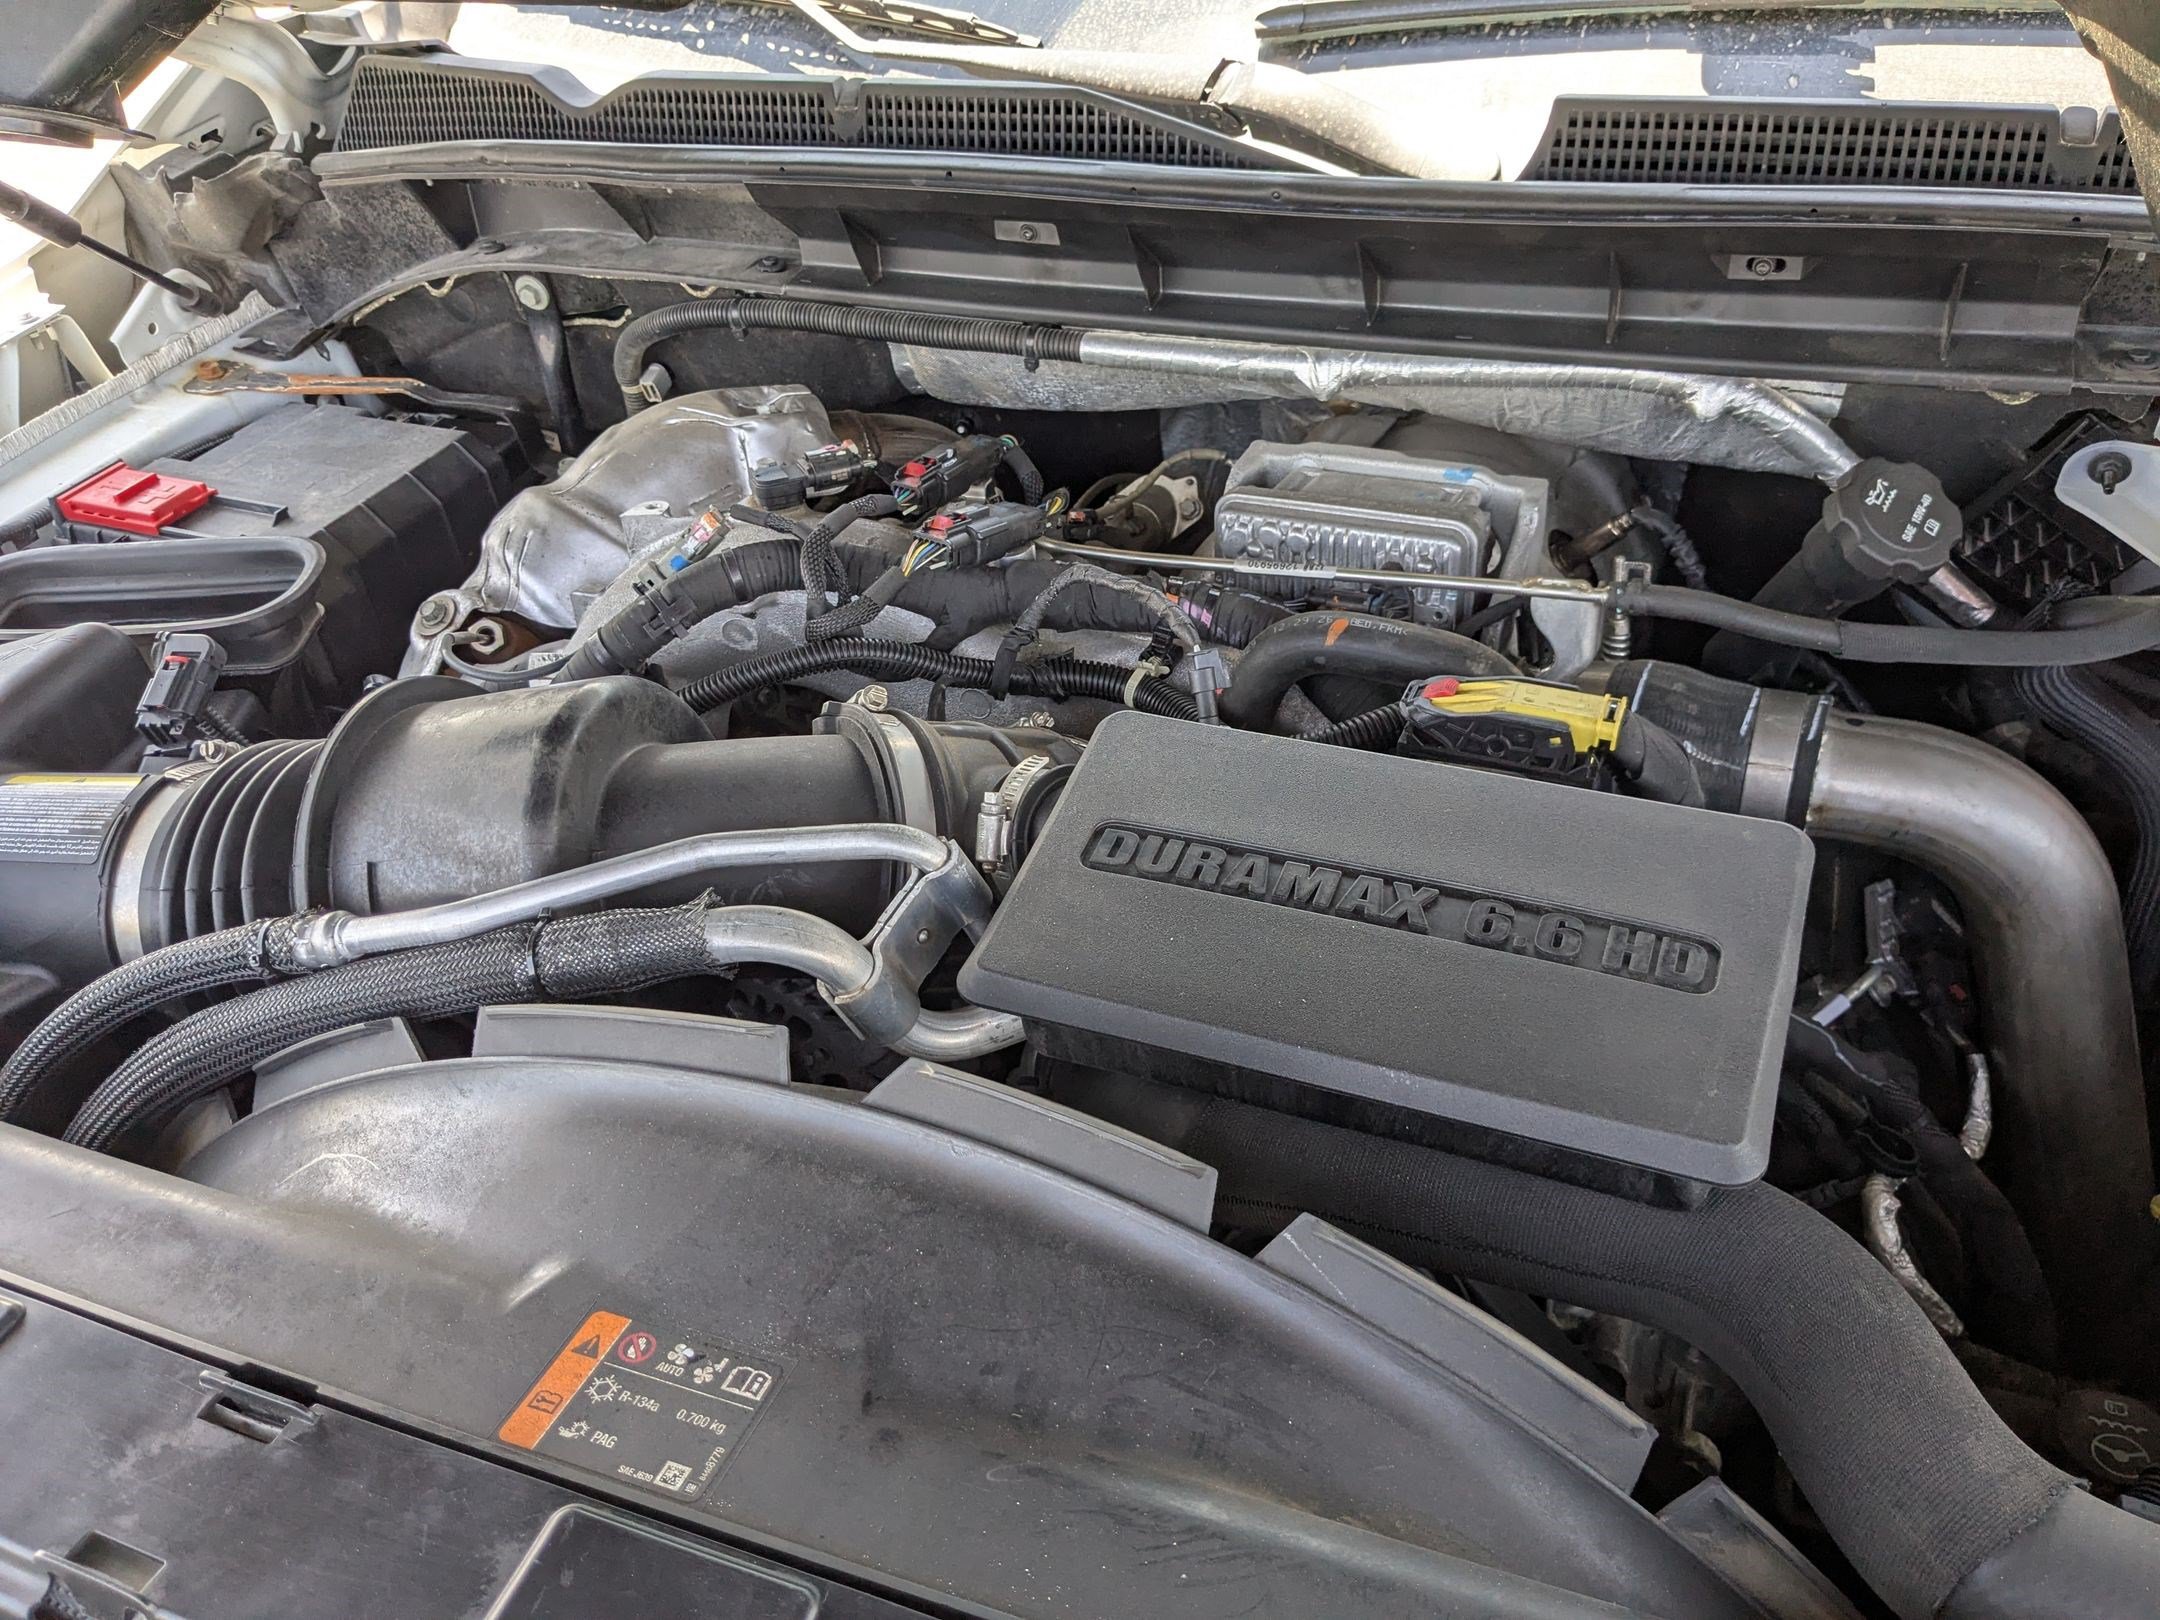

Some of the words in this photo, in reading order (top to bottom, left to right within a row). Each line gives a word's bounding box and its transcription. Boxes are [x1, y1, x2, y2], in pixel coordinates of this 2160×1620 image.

[1902, 523, 1917, 542] SAE
[1912, 493, 1933, 524] 15W-40
[1092, 827, 1439, 932] DURAMAX
[1464, 898, 1584, 959] 6.6
[1601, 924, 1710, 985] HD
[655, 1361, 685, 1377] AUTO
[618, 1390, 660, 1412] R-134a
[676, 1408, 711, 1429] 0.700
[710, 1419, 727, 1435] kg
[590, 1430, 618, 1448] PAG
[617, 1464, 634, 1478] SAE
